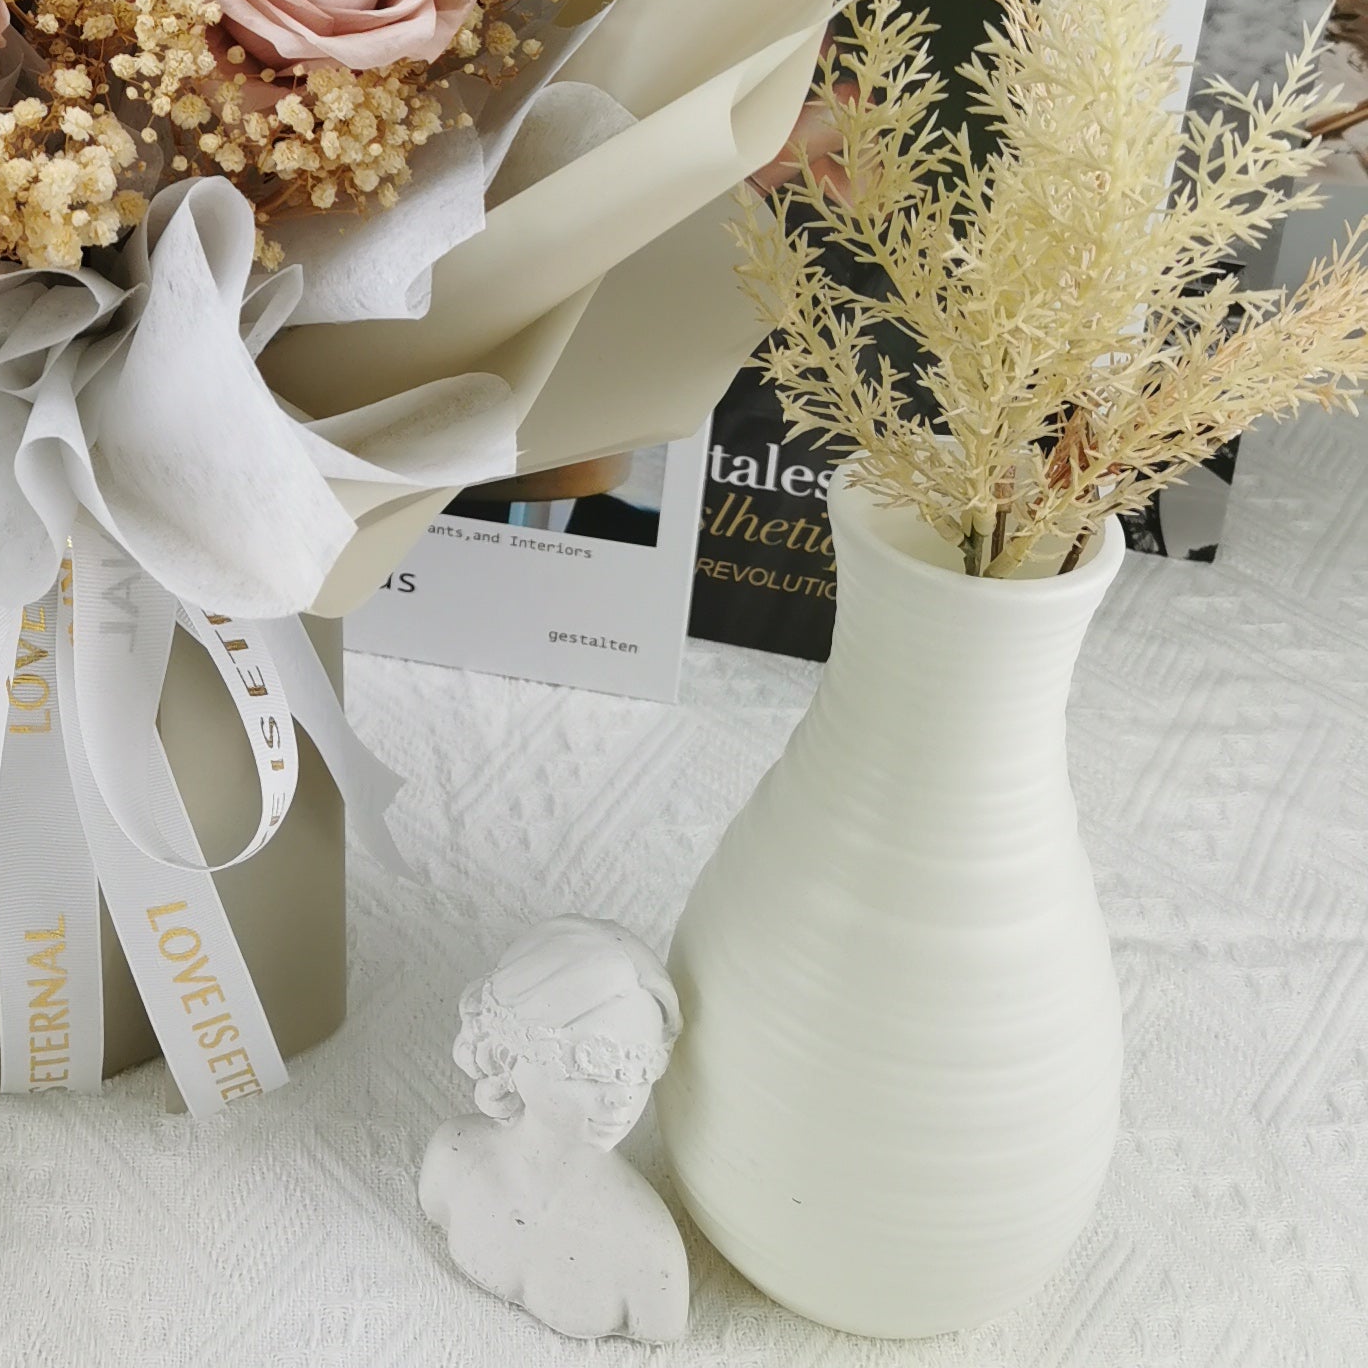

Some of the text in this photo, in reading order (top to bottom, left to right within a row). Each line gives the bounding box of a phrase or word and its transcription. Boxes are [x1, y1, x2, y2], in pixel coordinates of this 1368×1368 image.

[509, 534, 593, 559] Interiors
[6, 605, 53, 734] LOVE
[547, 629, 639, 654] gestalten
[24, 911, 72, 1085] ETERNAL
[146, 899, 227, 1015] LOVE
[191, 1012, 241, 1050] IS
